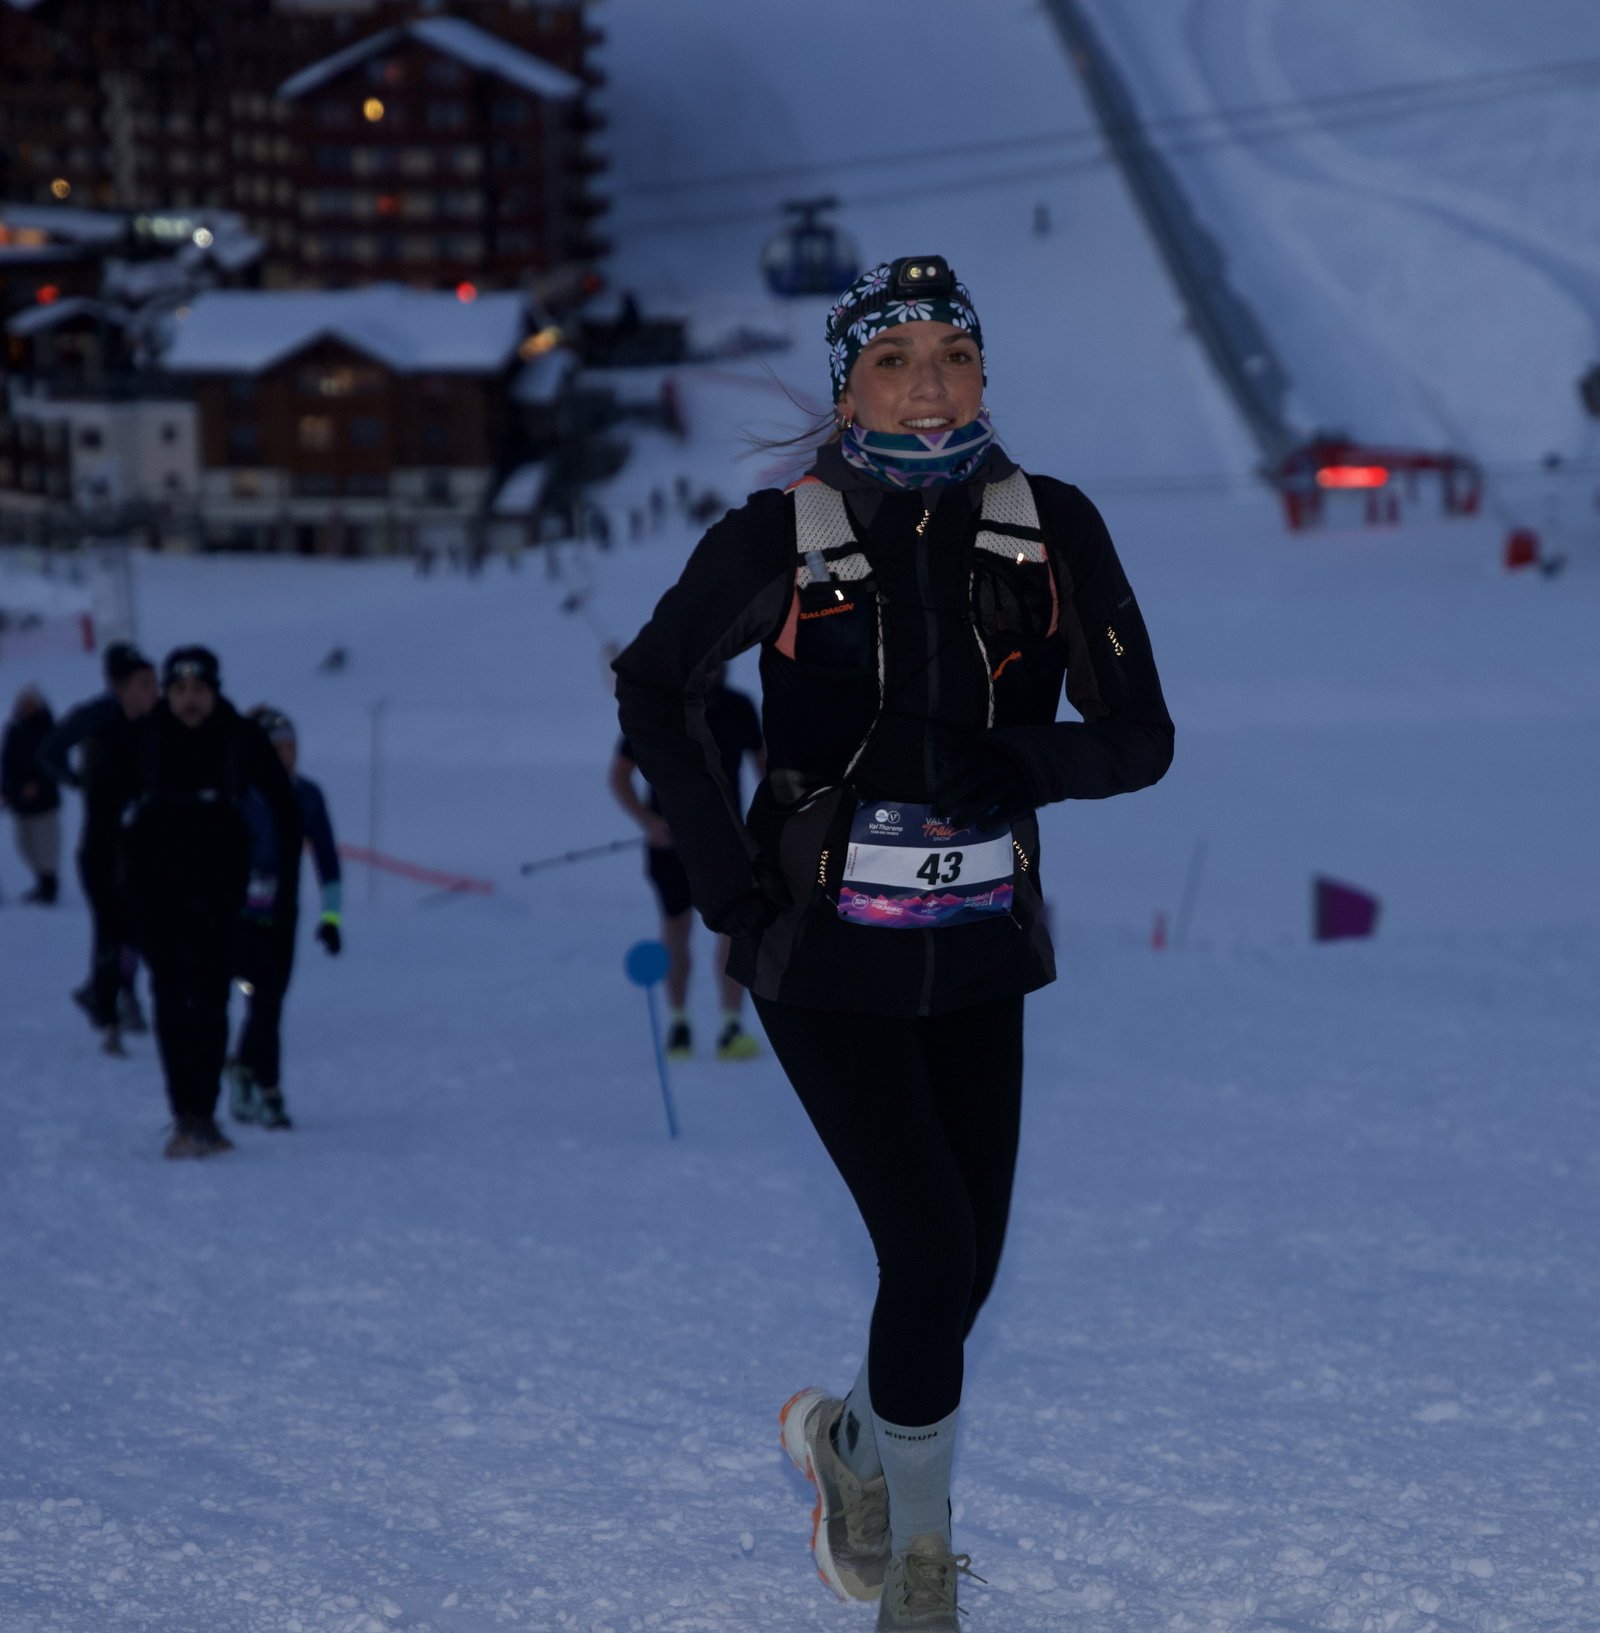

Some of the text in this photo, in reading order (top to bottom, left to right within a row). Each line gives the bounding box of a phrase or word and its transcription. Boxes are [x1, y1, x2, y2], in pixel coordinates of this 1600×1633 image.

[800, 602, 855, 620] SALOMON
[925, 817, 943, 825] VAL
[869, 822, 903, 832] Val Thorens
[916, 851, 963, 885] 43
[885, 1430, 937, 1441] KIPRUN
